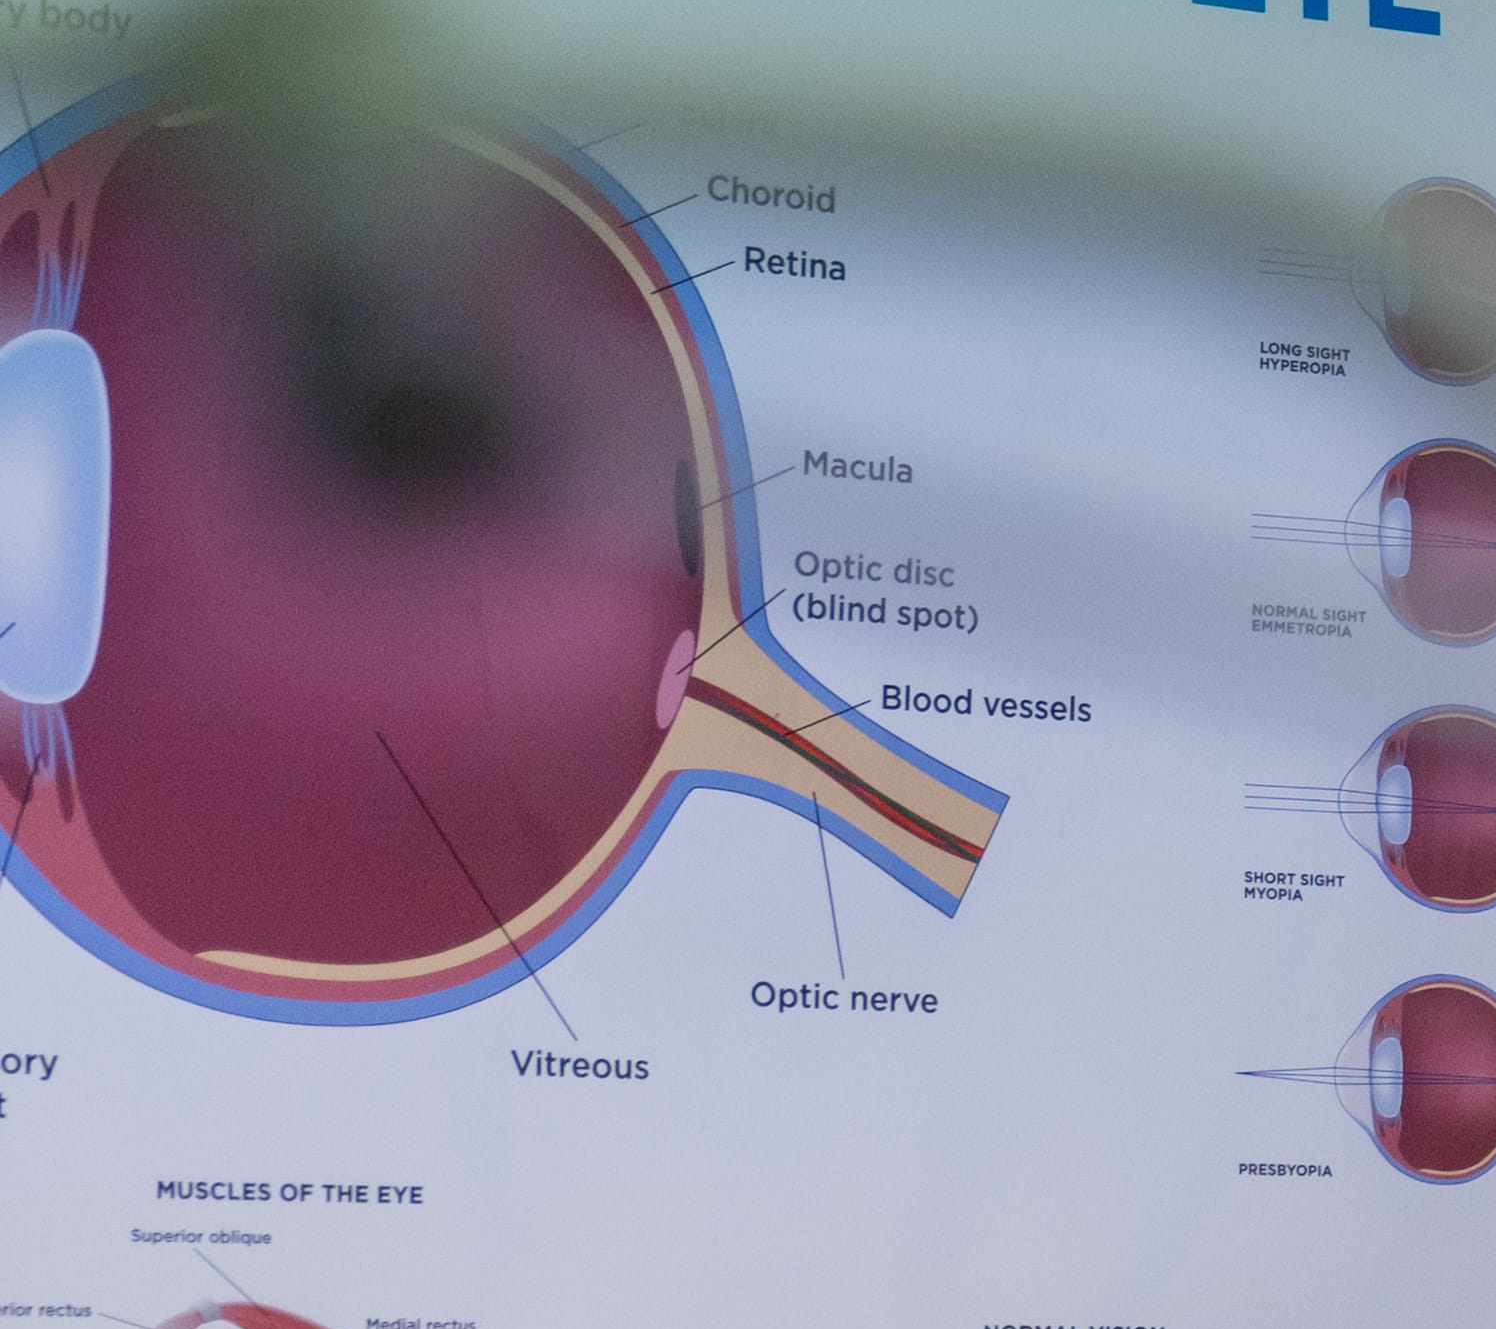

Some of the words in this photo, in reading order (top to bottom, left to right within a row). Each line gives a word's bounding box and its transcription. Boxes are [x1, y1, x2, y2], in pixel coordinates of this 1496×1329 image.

[707, 174, 836, 215] Choroid
[744, 247, 847, 283] Retina
[1259, 341, 1302, 358] LONG
[1306, 345, 1351, 362] SIGHT
[1259, 358, 1347, 377] HYPEROPIA
[803, 451, 913, 486] Macula
[794, 552, 882, 587] Optic
[892, 557, 954, 587] disc
[792, 593, 887, 629] (blind
[897, 599, 980, 635] spot)
[1251, 604, 1317, 621] NORMAL
[1322, 608, 1367, 624] SIGHT
[1251, 619, 1353, 638] EMMETROPIA
[881, 685, 973, 717] Blood
[982, 691, 1092, 722] vessels
[1244, 871, 1296, 888] SHORT
[1301, 872, 1344, 888] SIGHT
[1244, 887, 1303, 902] MYOPIA
[751, 981, 839, 1015] Optic
[849, 985, 938, 1015] nerve
[511, 1050, 649, 1081] Vitreous
[1239, 1162, 1333, 1178] PRESBYOPIA
[156, 1180, 271, 1202] MUSCLES
[279, 1184, 313, 1203] OF
[322, 1184, 369, 1203] THE
[377, 1185, 424, 1204] EYE
[131, 1227, 203, 1246] Superior
[209, 1228, 272, 1247] oblique
[39, 1303, 91, 1318] rectus
